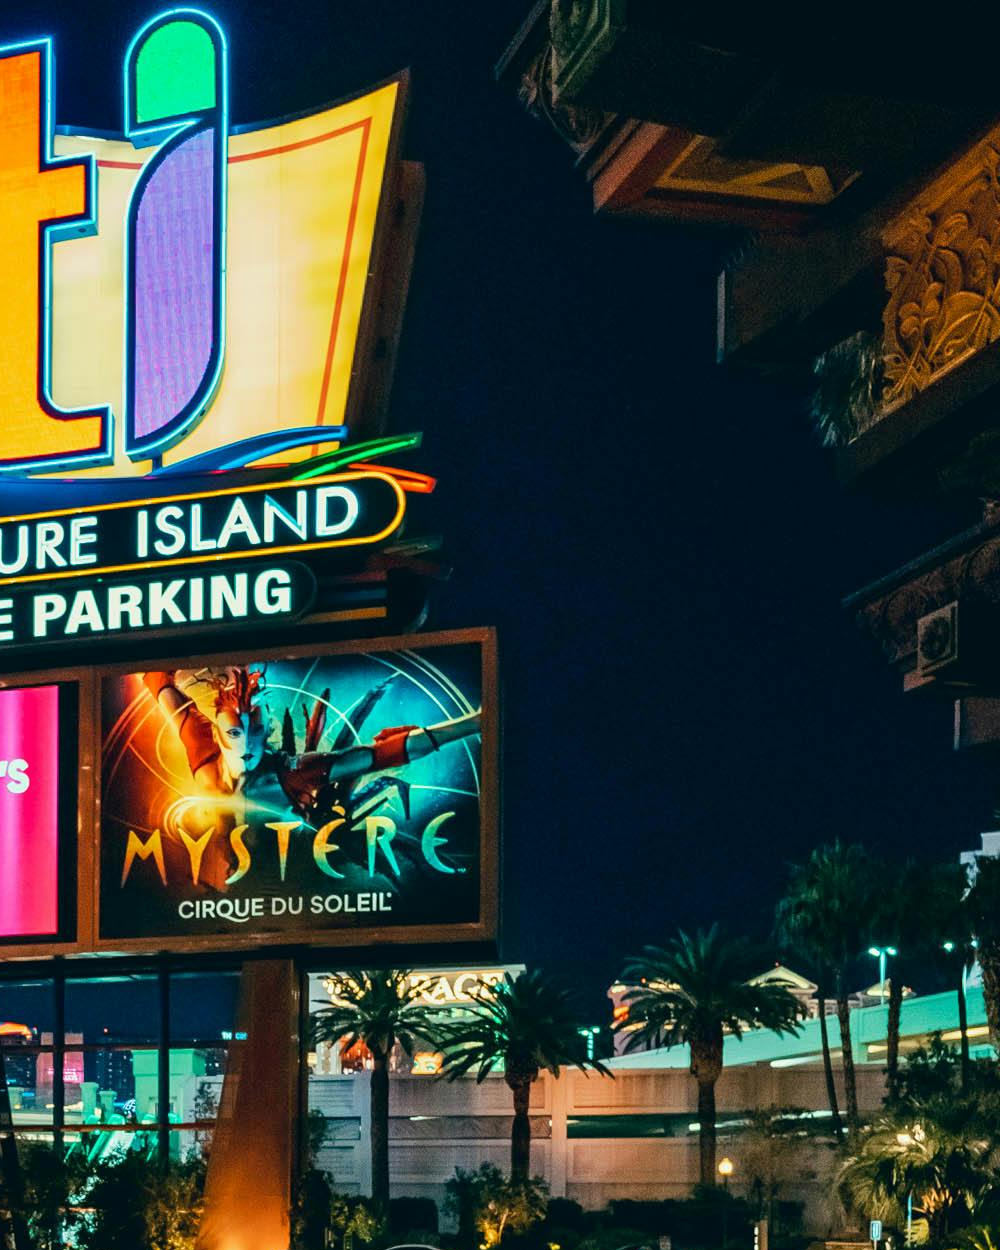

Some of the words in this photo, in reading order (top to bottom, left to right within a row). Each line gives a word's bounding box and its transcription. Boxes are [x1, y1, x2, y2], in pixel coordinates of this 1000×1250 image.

[136, 485, 360, 559] ISLAND
[33, 569, 293, 637] PARKING
[178, 897, 264, 923] CIRQUE
[271, 896, 304, 915] DU
[310, 893, 392, 914] SOLEIL
